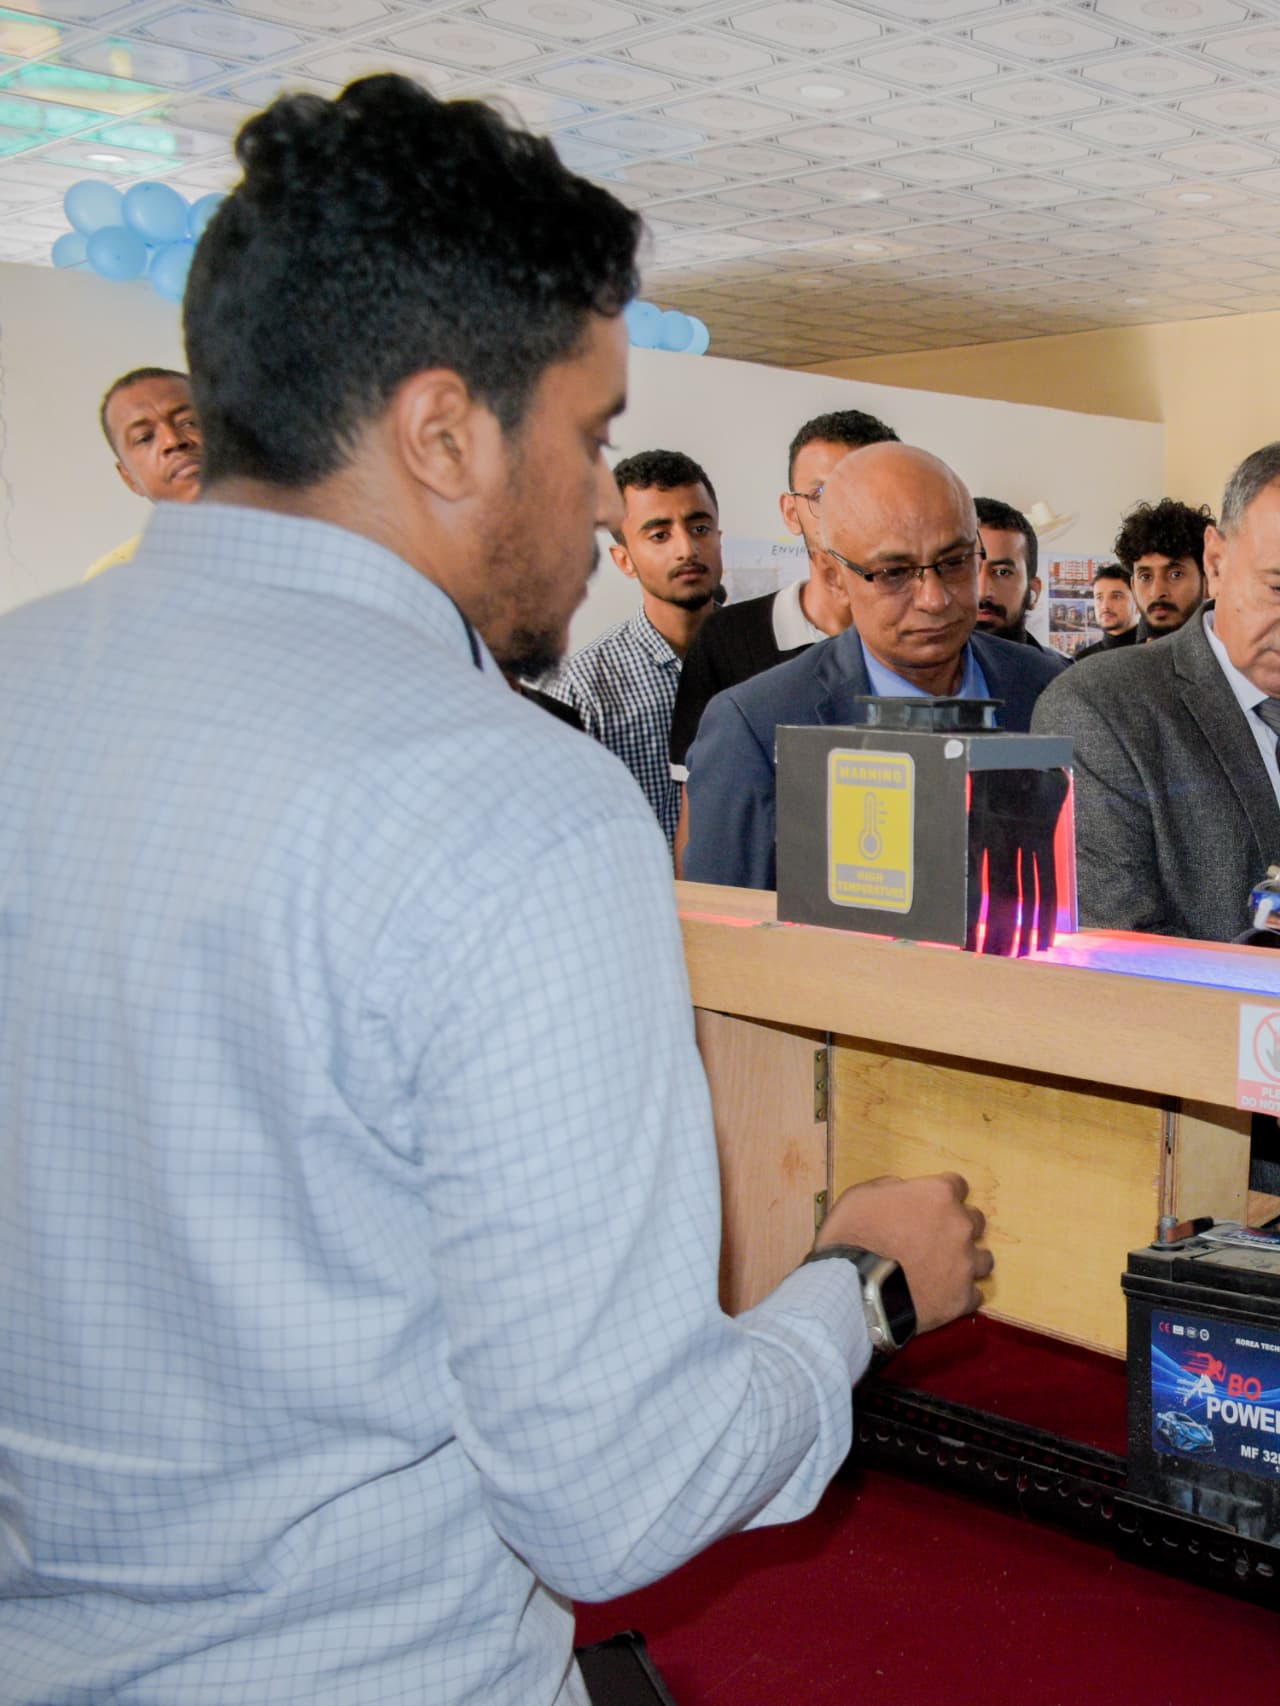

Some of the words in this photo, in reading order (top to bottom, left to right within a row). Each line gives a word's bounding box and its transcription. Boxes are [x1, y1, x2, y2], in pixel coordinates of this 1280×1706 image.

[839, 765, 903, 784] WARNING
[857, 871, 884, 882] HIGH
[838, 880, 904, 898] TEMPERATURE
[1241, 1095, 1257, 1108] DO
[1235, 1338, 1260, 1349] KOREA
[1227, 1372, 1262, 1400] BO
[1240, 1444, 1260, 1460] MF
